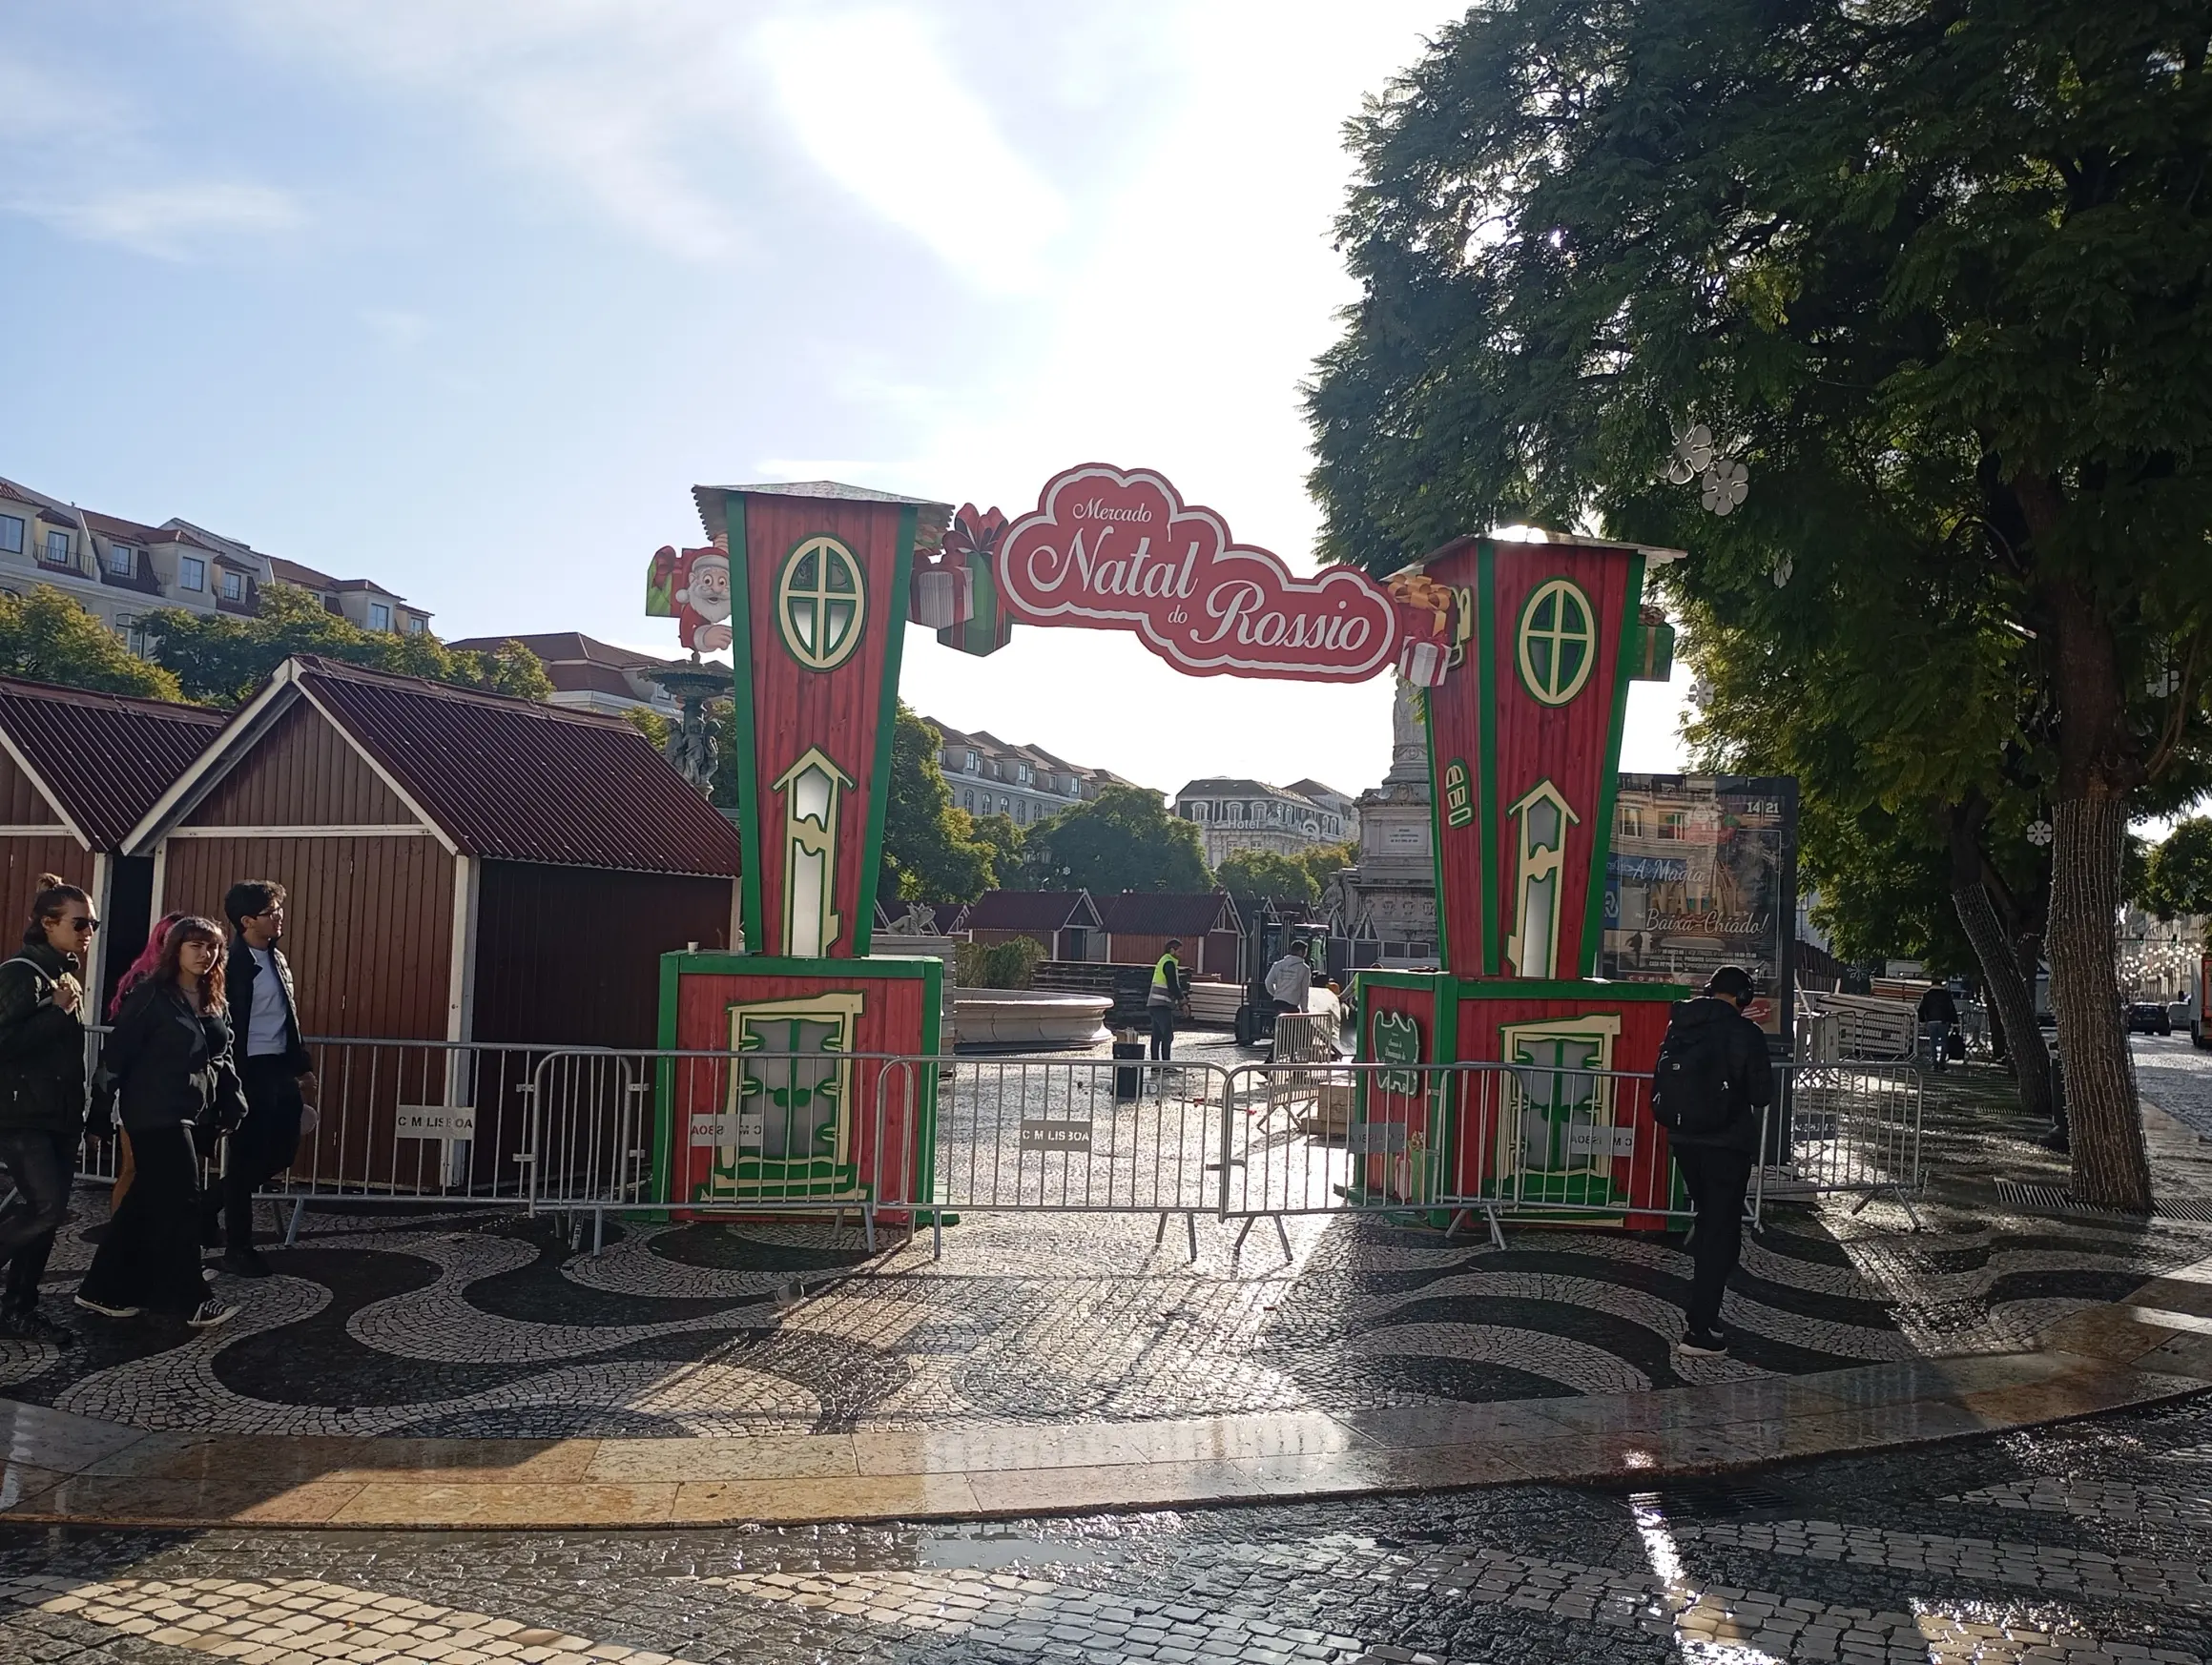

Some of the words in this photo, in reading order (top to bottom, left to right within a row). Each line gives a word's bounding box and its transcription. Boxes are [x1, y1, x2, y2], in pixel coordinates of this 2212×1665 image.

[1072, 497, 1152, 523] Mercado
[1027, 525, 1200, 599] Natal
[1168, 604, 1189, 624] do
[1189, 579, 1371, 650] Rossio
[1747, 801, 1761, 813] 14
[1765, 802, 1779, 813] 21
[1229, 819, 1260, 830] Hotel
[1651, 859, 1706, 887] Magia
[398, 1117, 406, 1126] C
[411, 1117, 422, 1127] M
[1022, 1130, 1030, 1140] C
[1034, 1130, 1044, 1141] M
[1048, 1131, 1090, 1141] LISBOA
